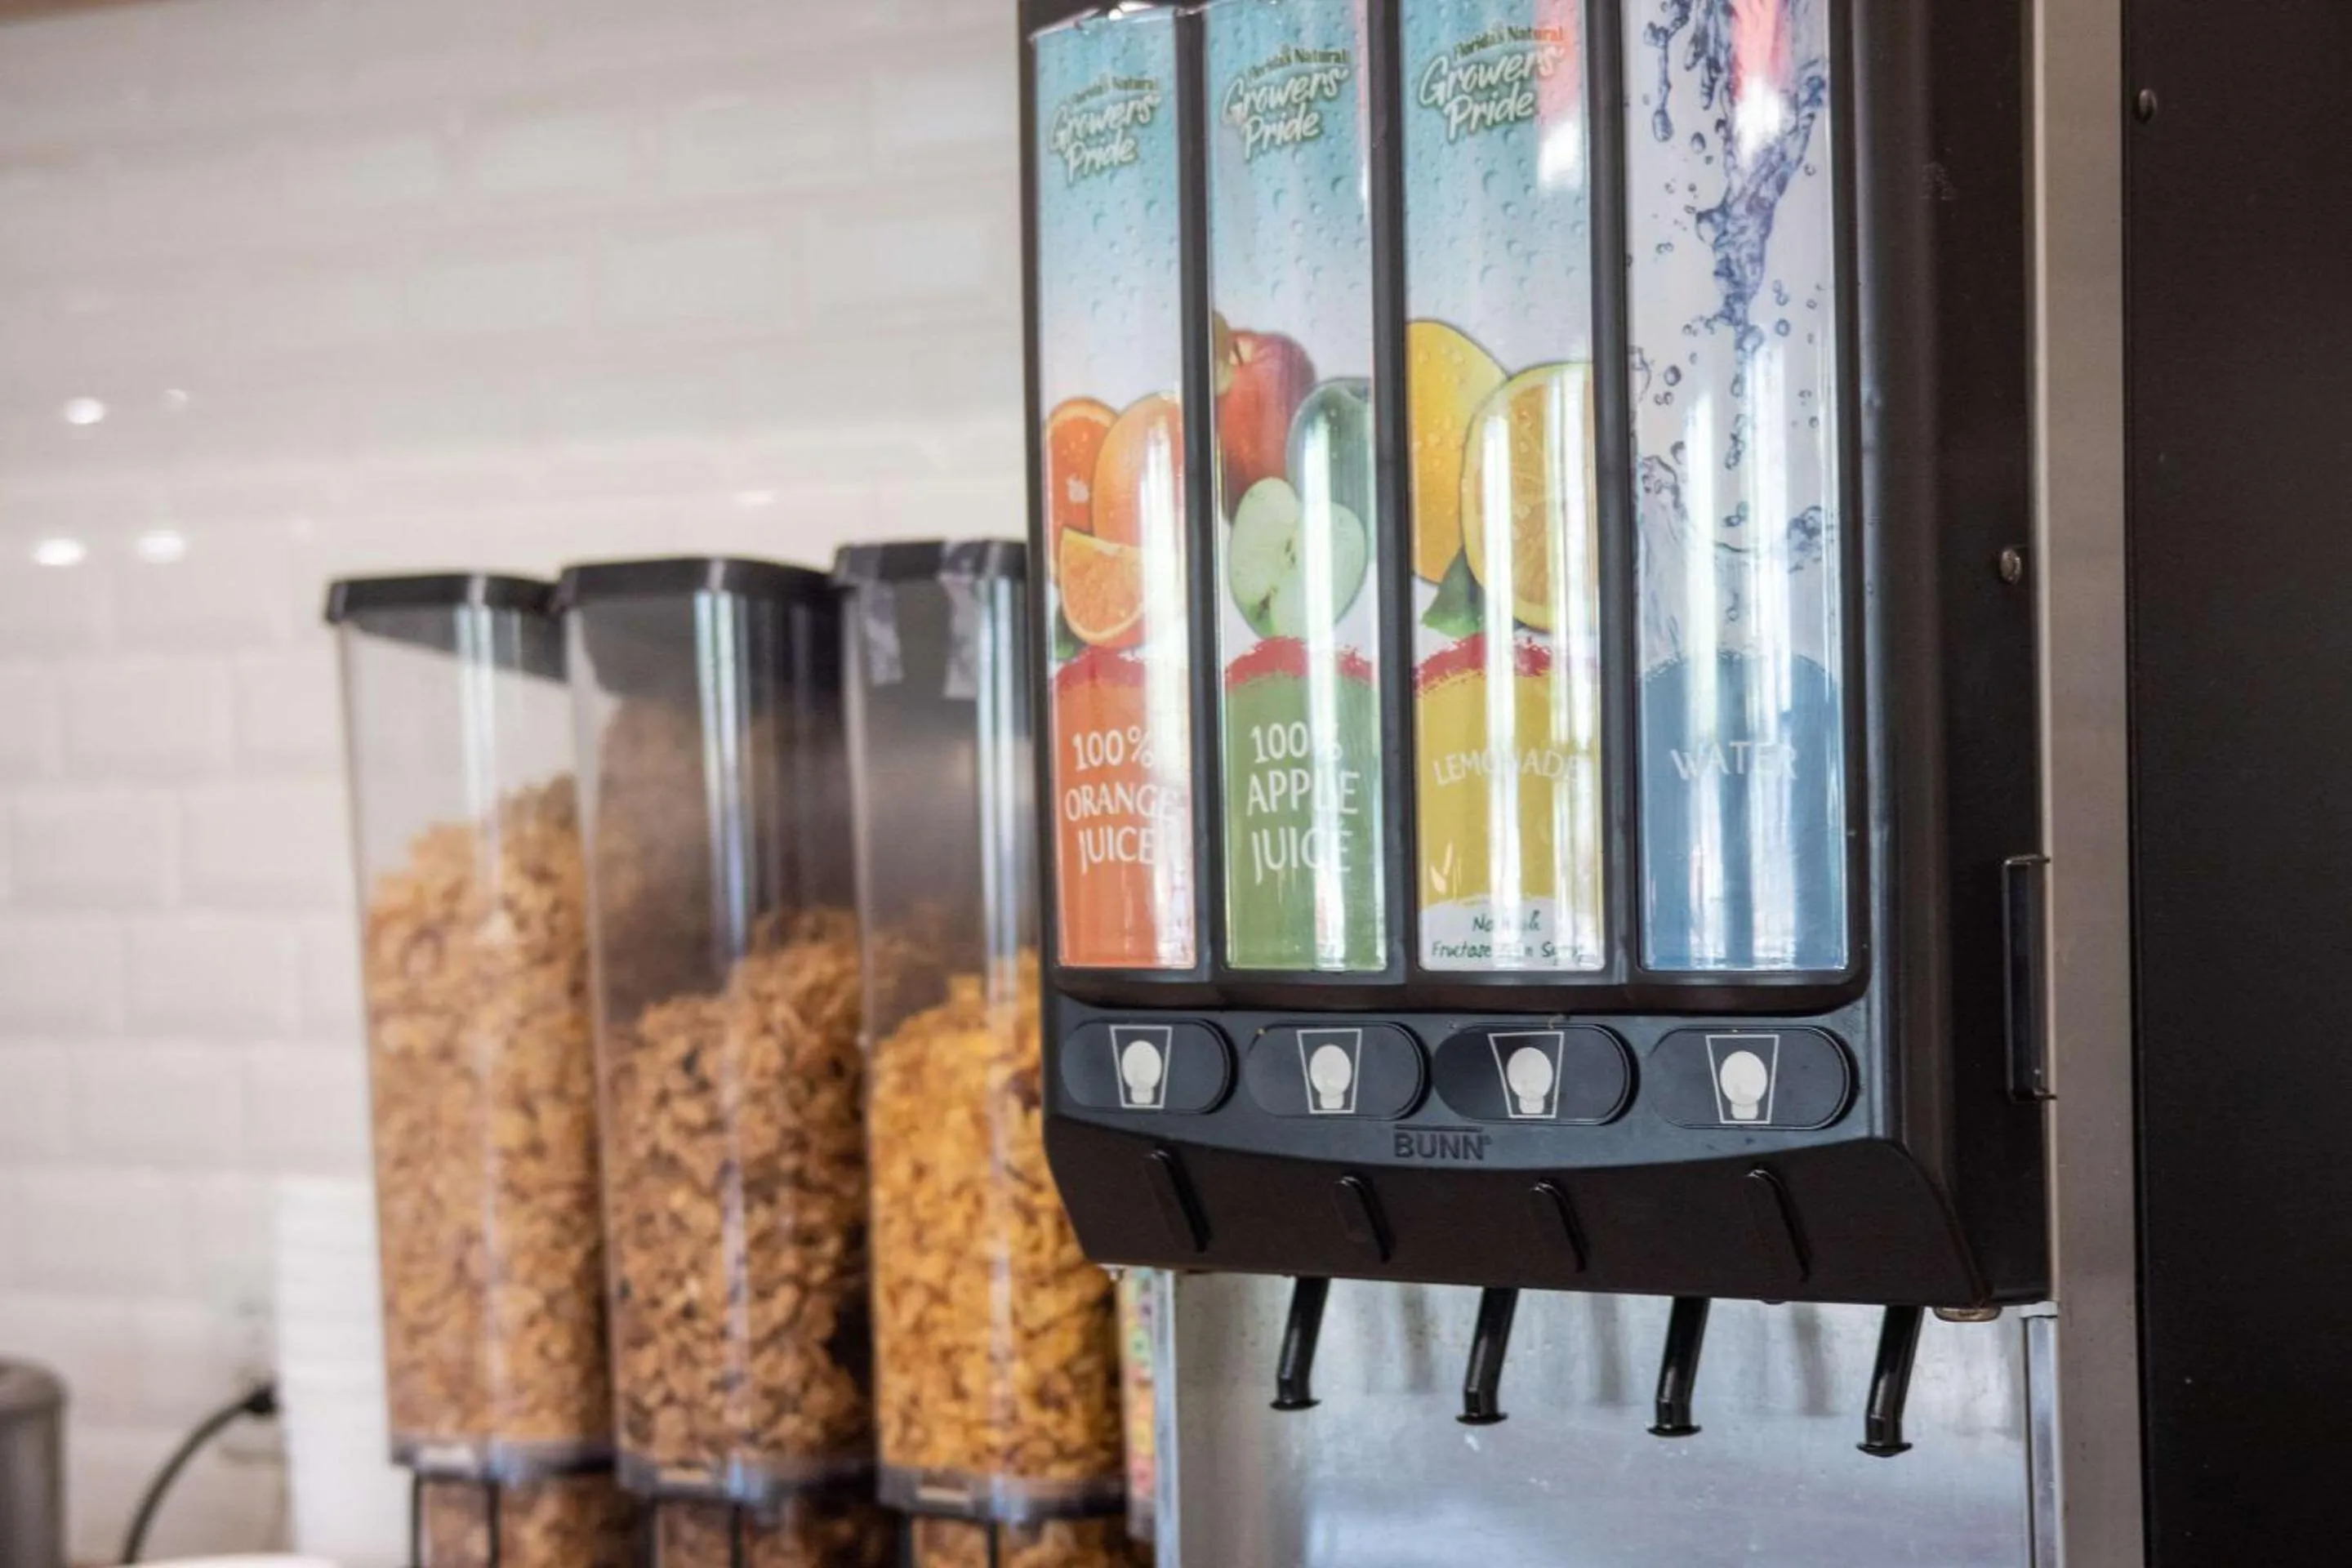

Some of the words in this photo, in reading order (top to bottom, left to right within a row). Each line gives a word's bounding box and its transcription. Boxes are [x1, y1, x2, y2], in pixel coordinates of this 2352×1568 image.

[1243, 102, 1320, 159] Pride
[1444, 82, 1535, 140] Pride
[1064, 127, 1136, 183] Pride
[1071, 725, 1154, 771] 100%
[1246, 768, 1361, 817] APPLE
[1078, 824, 1156, 876] JUICE
